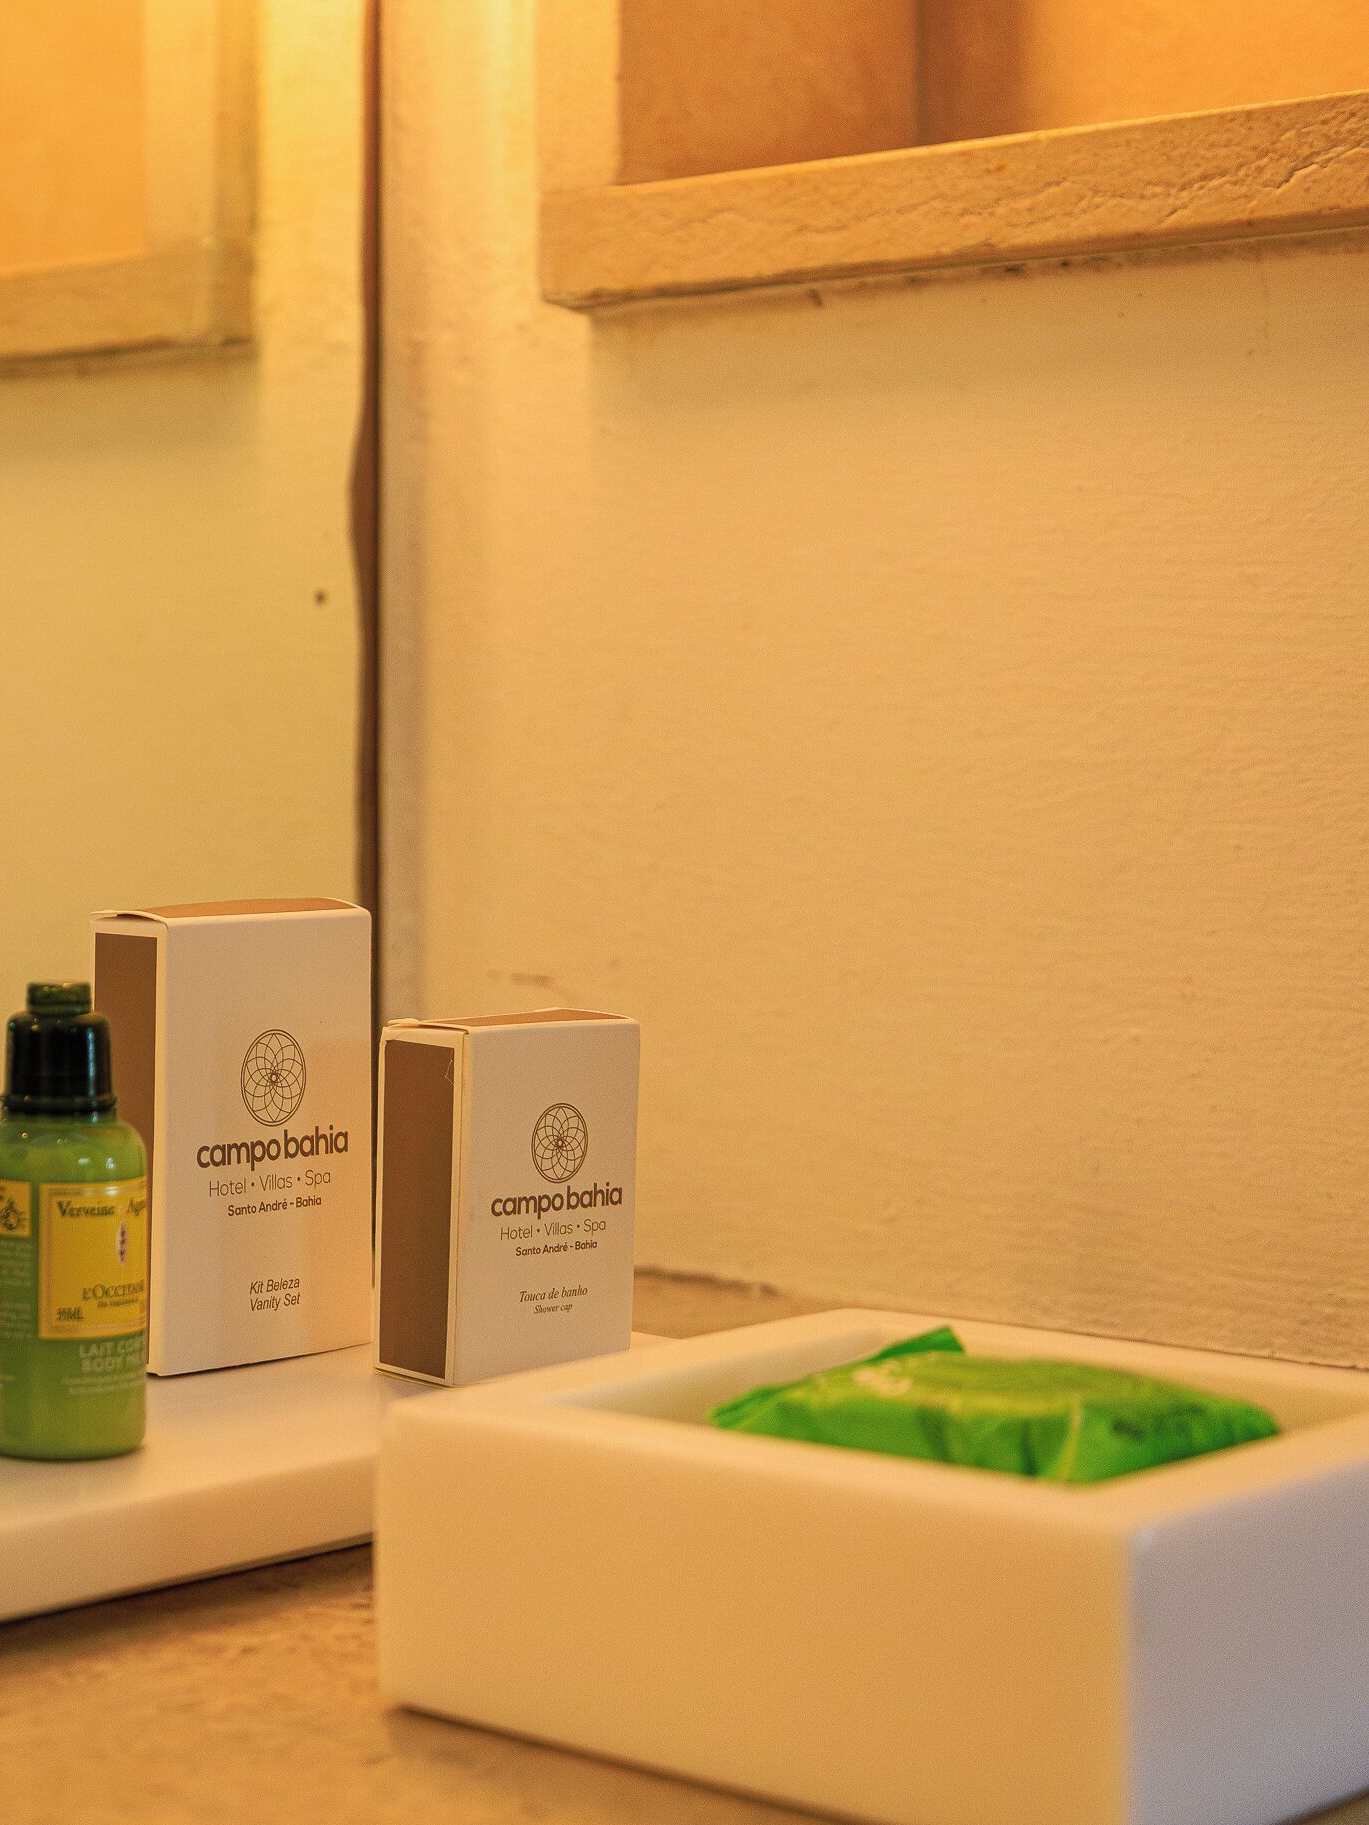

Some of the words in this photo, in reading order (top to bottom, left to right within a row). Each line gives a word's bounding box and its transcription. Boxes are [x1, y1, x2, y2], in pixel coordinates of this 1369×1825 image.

[209, 1178, 247, 1197] Hotel
[259, 1173, 293, 1191] Villas
[305, 1169, 331, 1189] Spa
[227, 1204, 257, 1216] Santo
[258, 1198, 288, 1213] André
[296, 1195, 322, 1208] Bahia
[500, 1225, 533, 1240] Hotel
[544, 1221, 574, 1236] Villas
[583, 1218, 607, 1235] Spa
[515, 1246, 541, 1257] Santo
[542, 1242, 568, 1254] André
[575, 1240, 598, 1250] Bahia
[249, 1281, 265, 1295] Kit
[266, 1277, 300, 1293] Beleza
[519, 1290, 546, 1303] Touca
[548, 1287, 560, 1299] de
[561, 1285, 588, 1299] banho
[249, 1295, 281, 1311] Vanity
[283, 1292, 301, 1306] Set
[533, 1304, 559, 1314] Shower
[560, 1303, 573, 1314] cap
